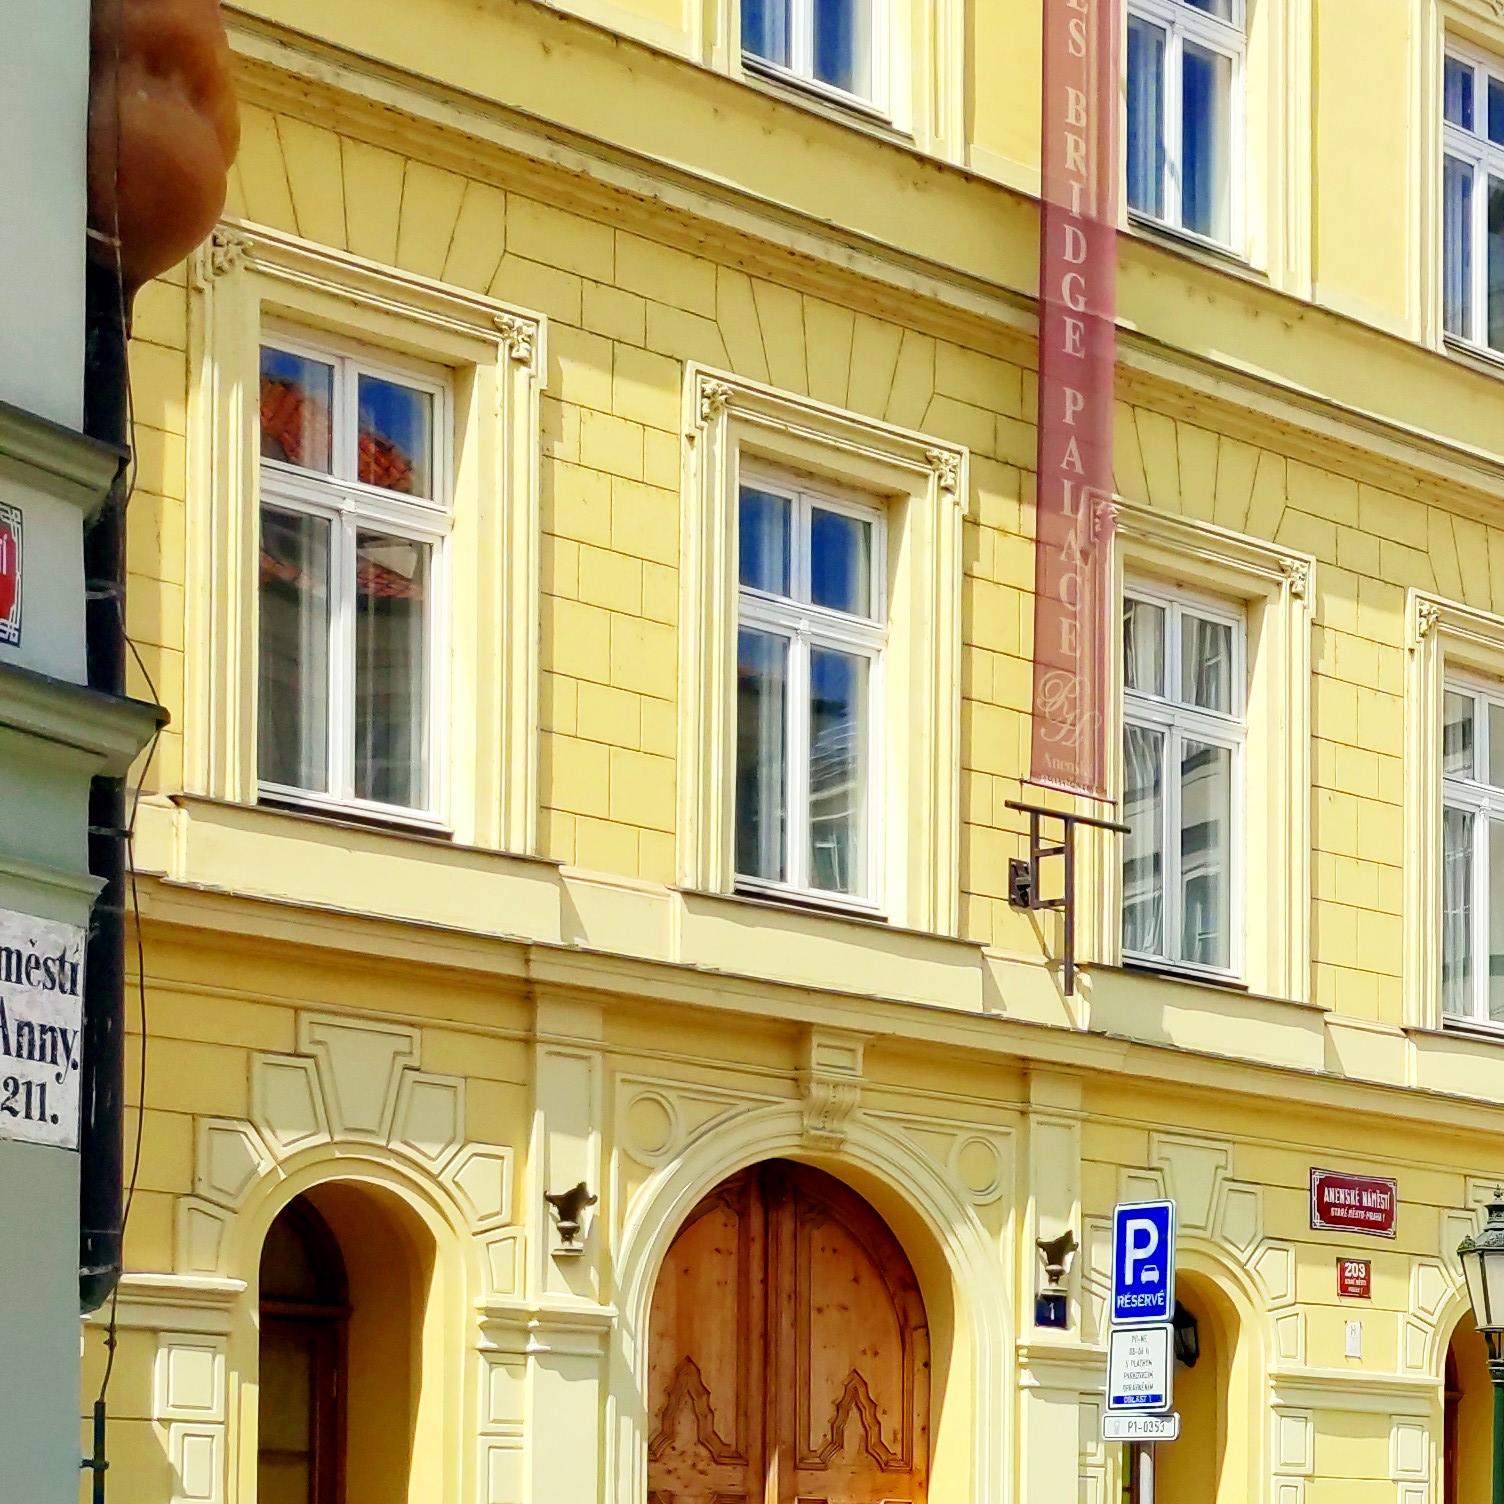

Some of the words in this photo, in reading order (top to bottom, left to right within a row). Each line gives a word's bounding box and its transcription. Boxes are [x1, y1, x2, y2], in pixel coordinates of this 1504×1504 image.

[1061, 86, 1088, 360] BRIDGE
[1059, 386, 1088, 658] PALACE
[1, 1075, 59, 1125] 211.
[1323, 1186, 1360, 1206] ANENSKÉ
[1361, 1188, 1390, 1211] NÁMĚSTÍ
[1124, 1218, 1160, 1286] P
[1116, 1289, 1165, 1309] RÉSERVÉ
